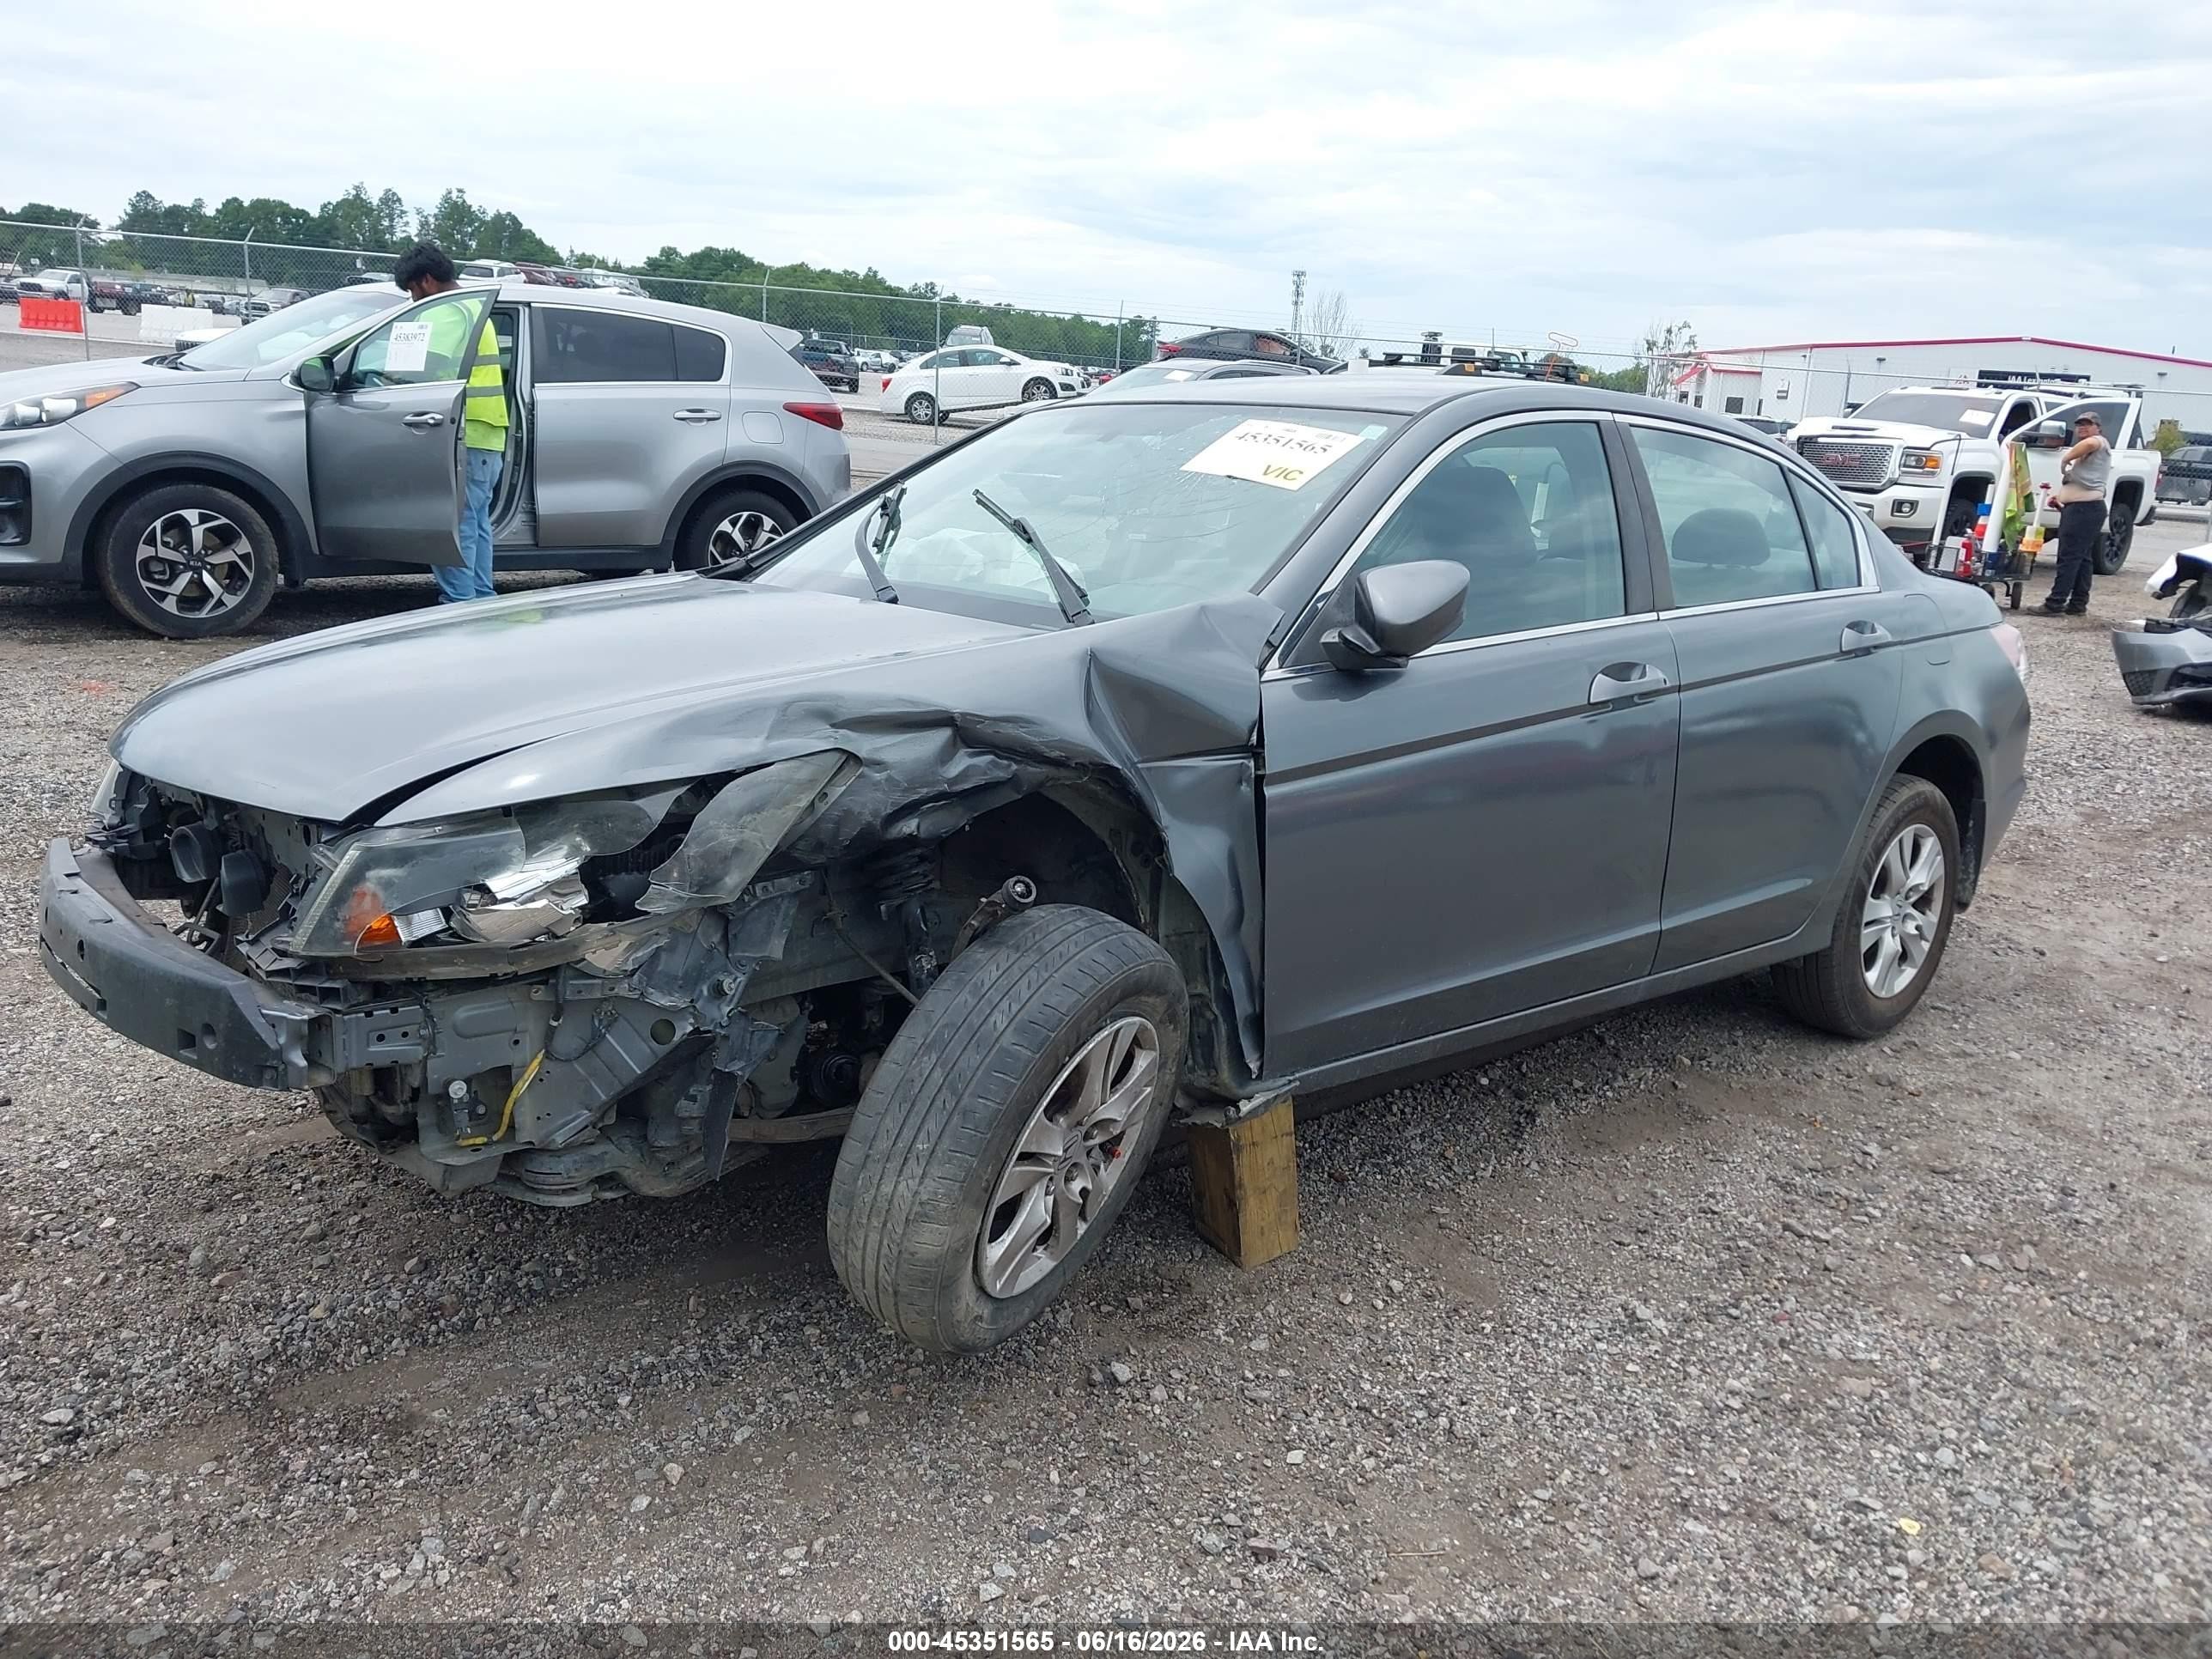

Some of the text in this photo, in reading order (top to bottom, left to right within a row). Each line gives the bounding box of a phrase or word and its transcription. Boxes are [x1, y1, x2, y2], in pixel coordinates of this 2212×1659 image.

[393, 332, 426, 342] 45383972
[1235, 431, 1334, 454] 45351565
[1823, 453, 1862, 465] GMC
[1261, 464, 1304, 482] VIC
